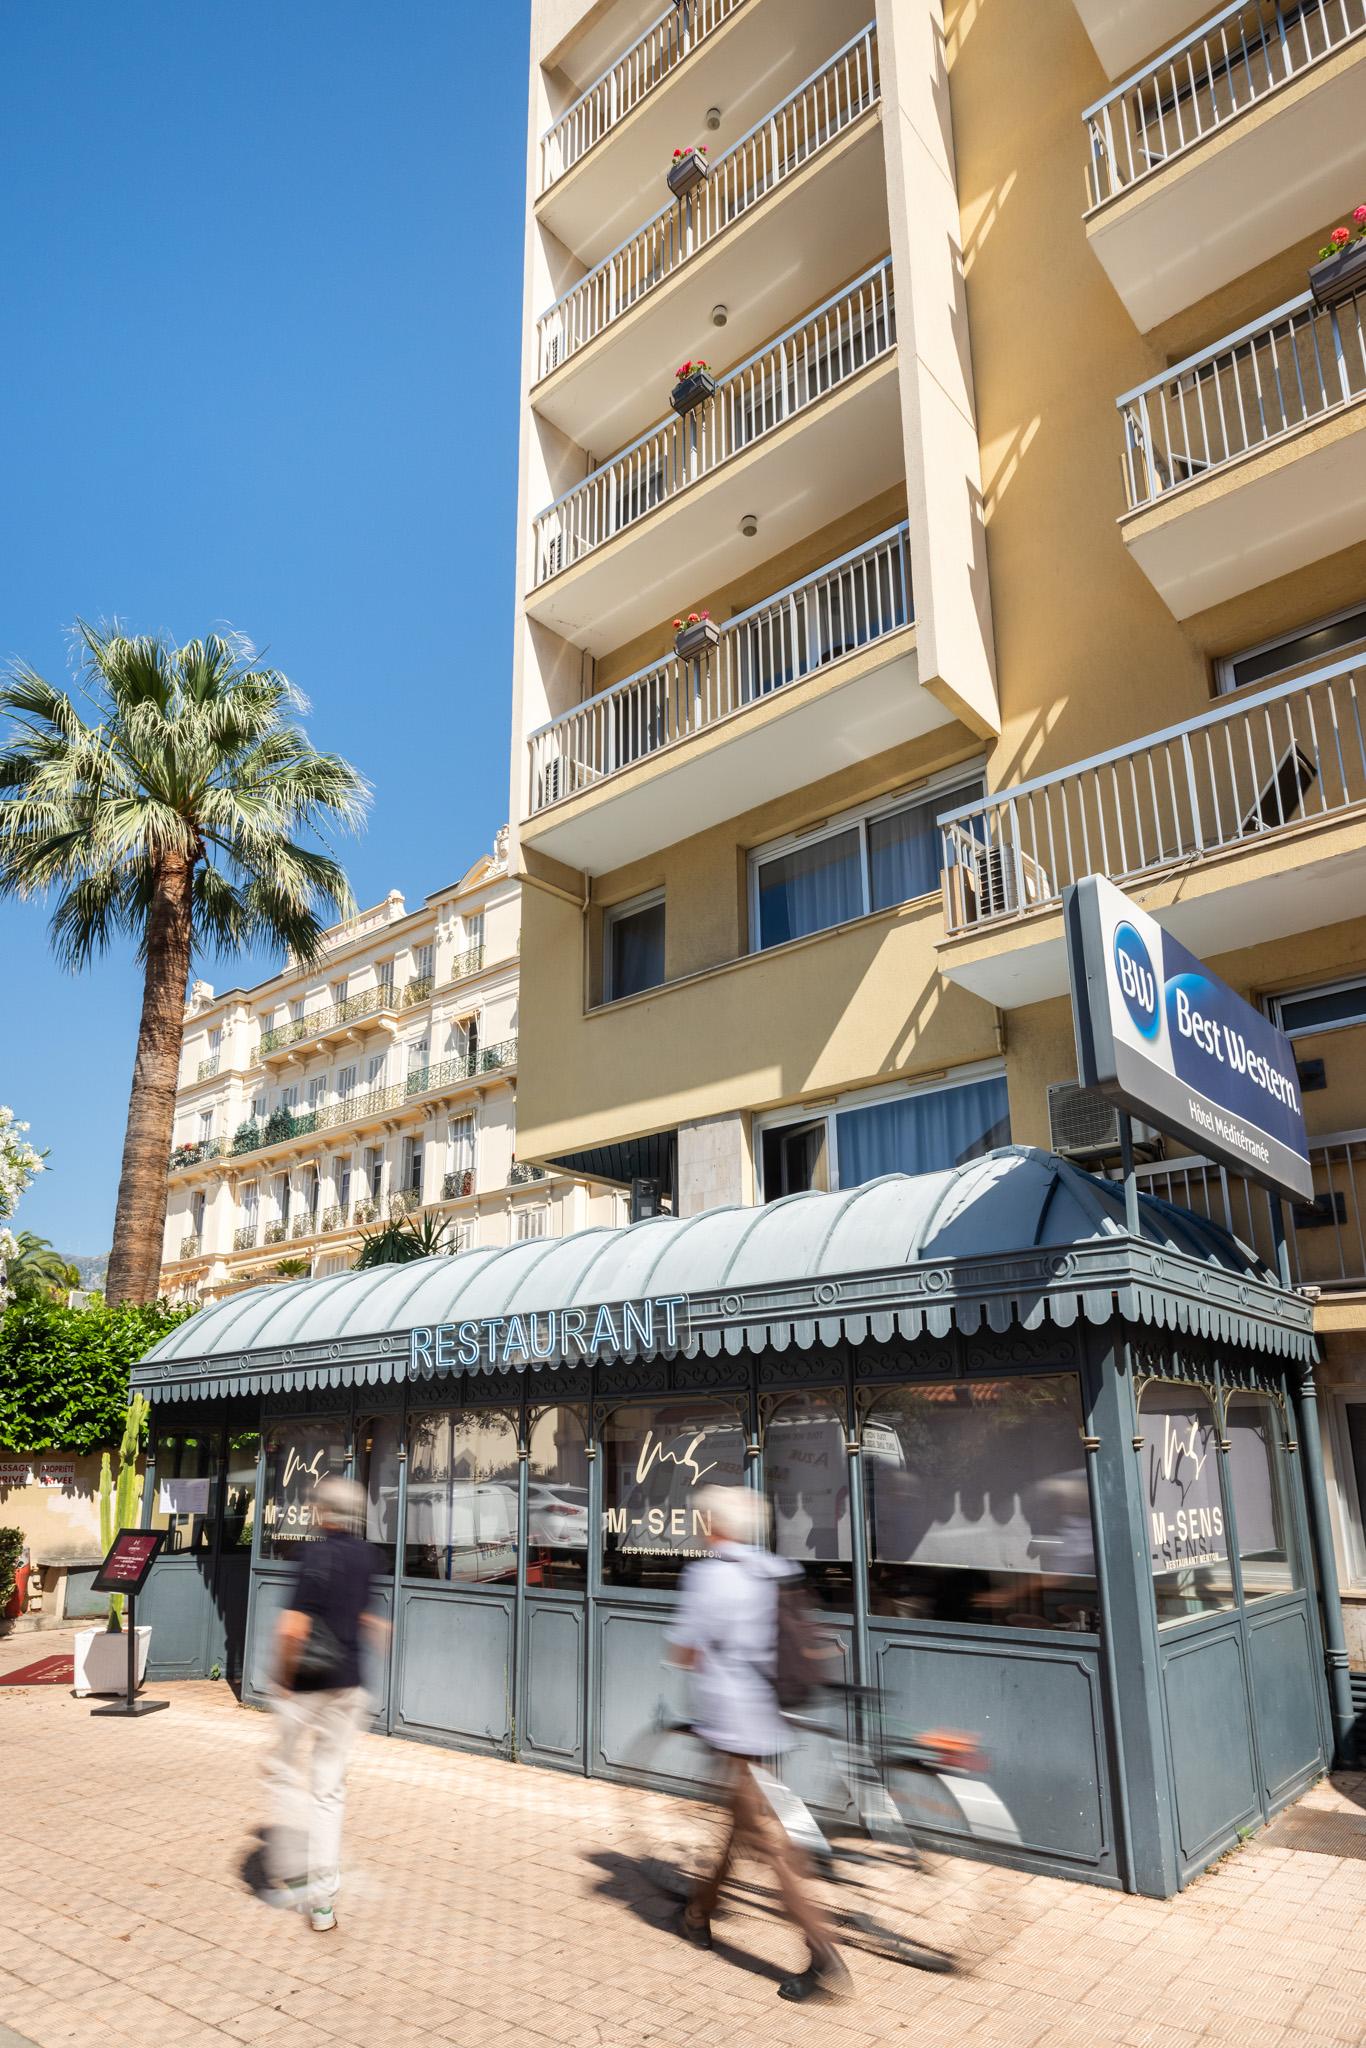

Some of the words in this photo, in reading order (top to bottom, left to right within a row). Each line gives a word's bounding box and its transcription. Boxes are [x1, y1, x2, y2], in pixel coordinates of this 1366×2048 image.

[1118, 948, 1154, 1014] BW
[1176, 987, 1224, 1062] Best
[1189, 1099, 1215, 1133] Hôtel
[410, 1296, 685, 1369] RESTAURANT
[264, 1504, 324, 1526] M-SEN
[607, 1507, 713, 1537] M-SEN
[1151, 1506, 1223, 1545] M-SENS
[270, 1532, 304, 1542] RESTAURANT
[621, 1541, 680, 1557] RESTAURANT
[682, 1548, 722, 1559] MENTON
